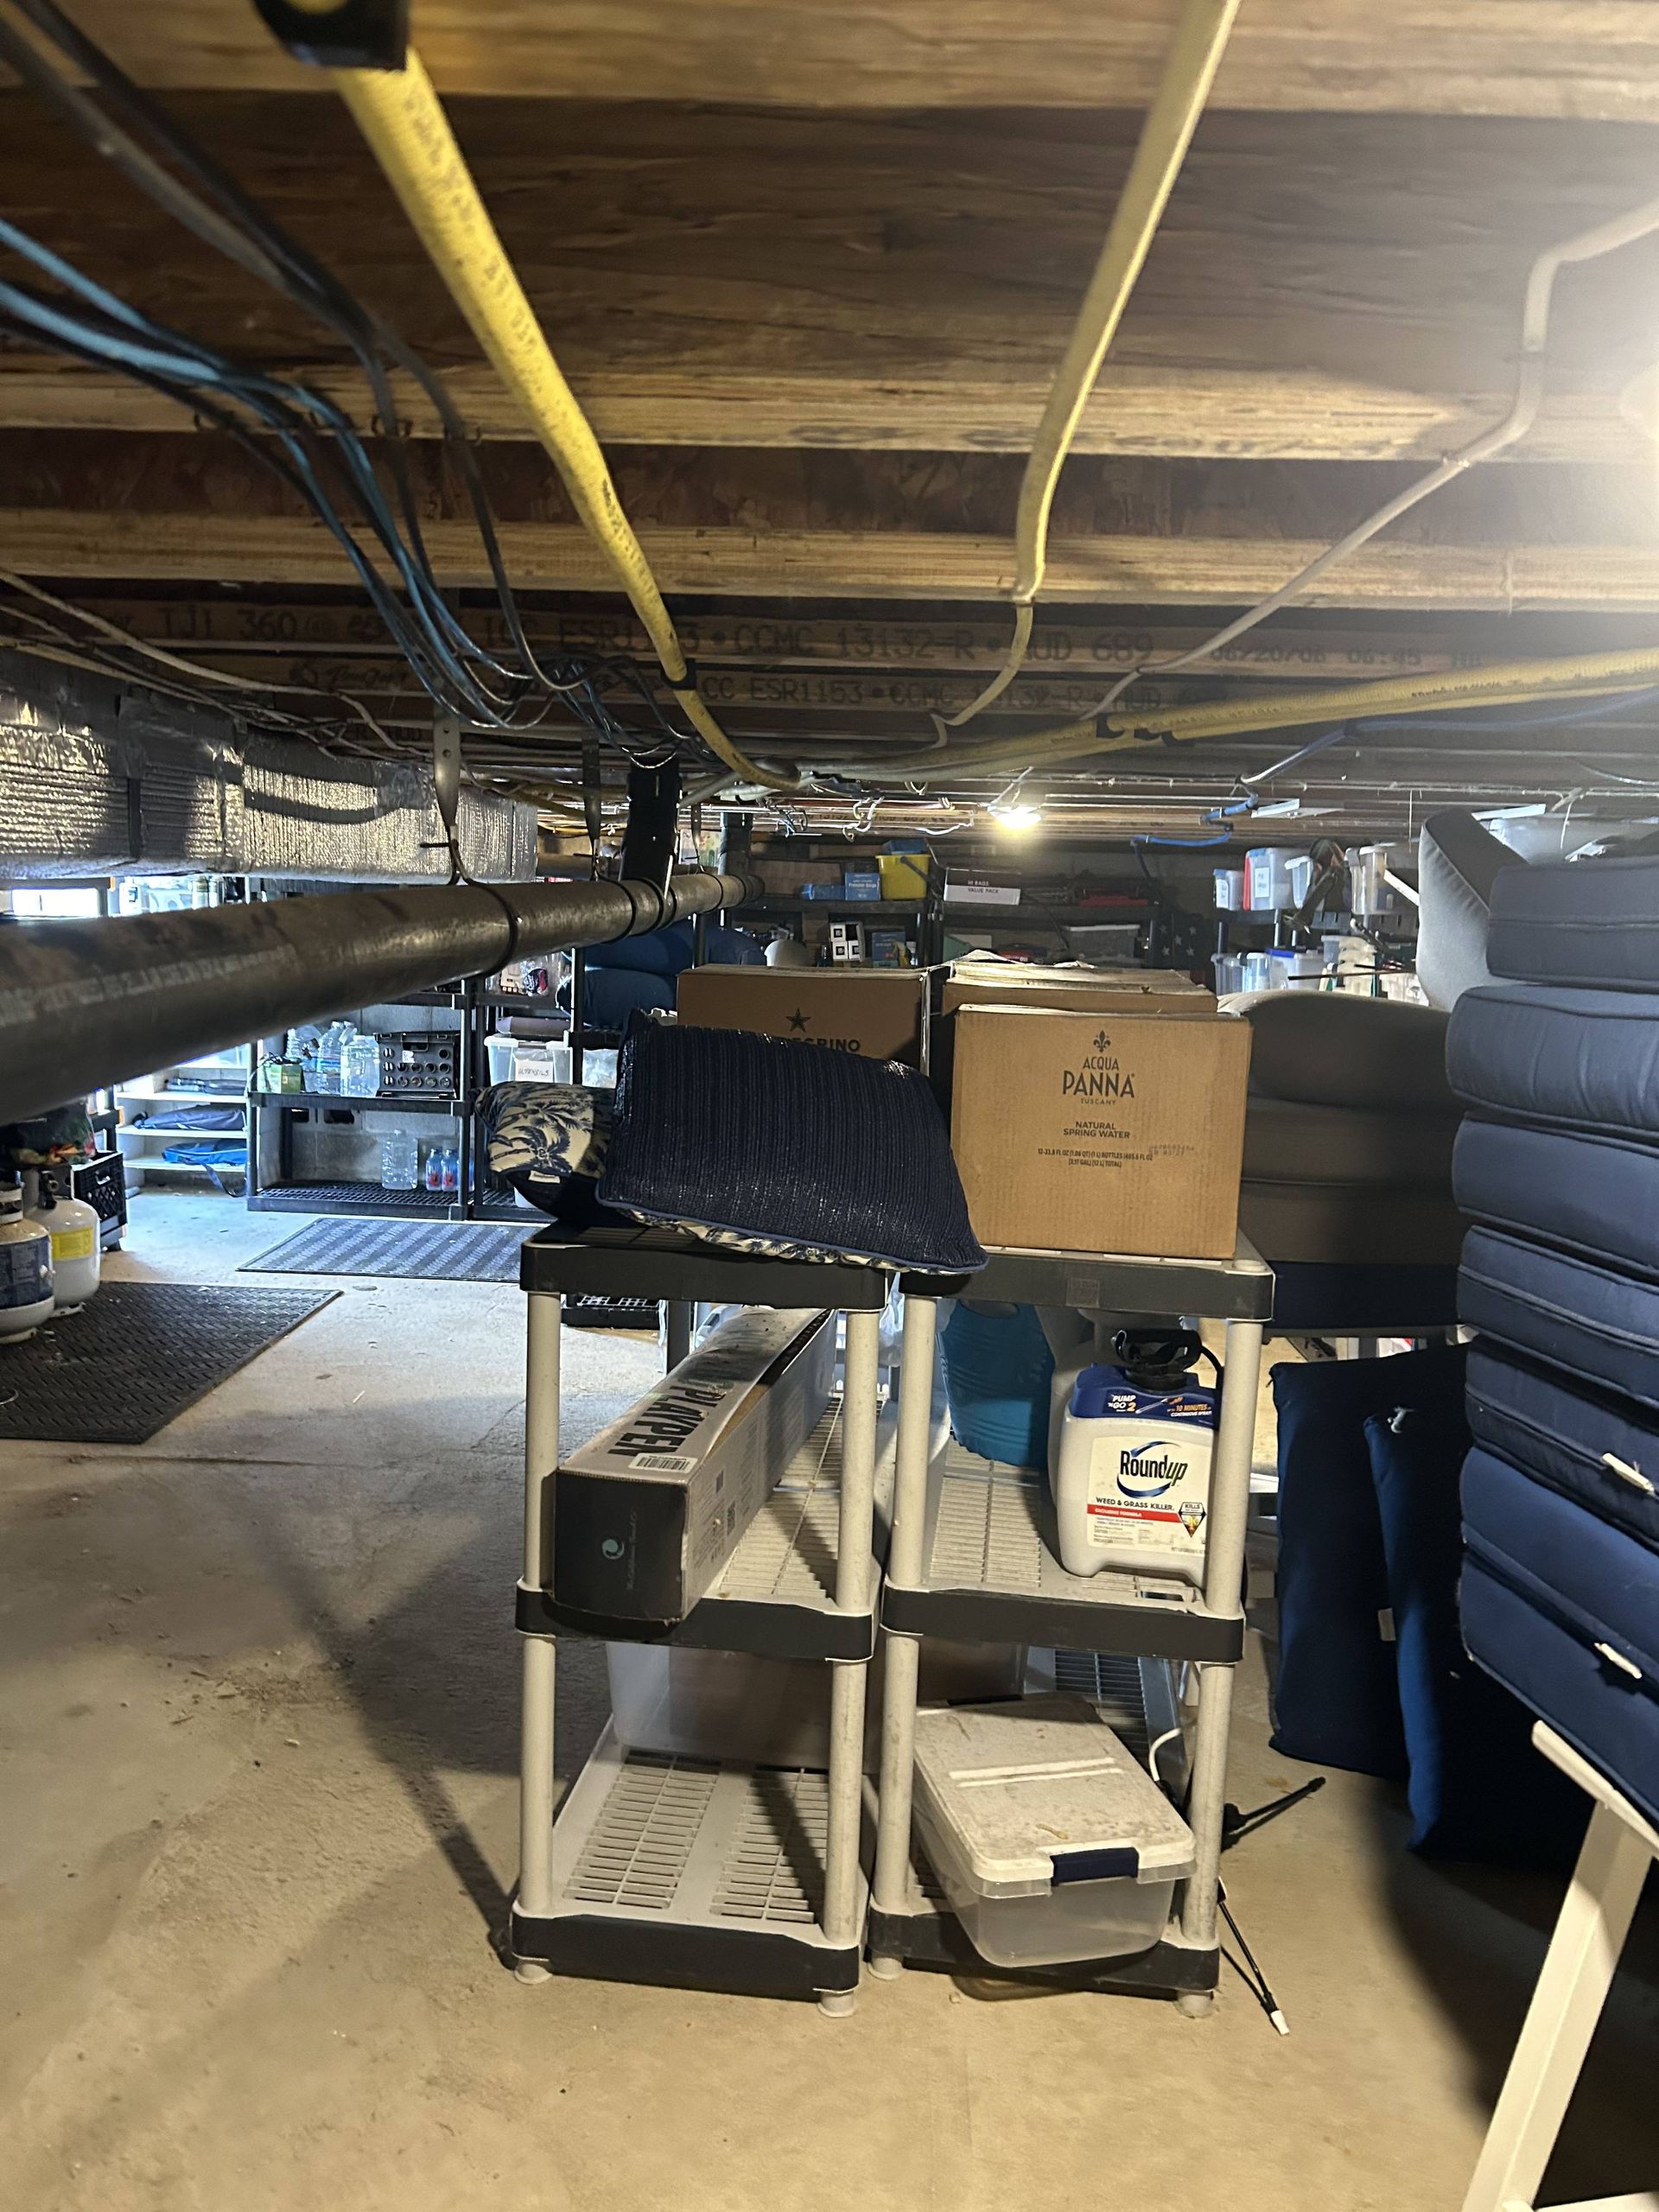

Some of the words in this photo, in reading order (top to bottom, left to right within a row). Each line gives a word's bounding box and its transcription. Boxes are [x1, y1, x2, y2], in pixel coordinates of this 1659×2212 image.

[237, 607, 297, 639] 360
[560, 617, 699, 652] ESR113
[734, 624, 811, 654] CCMC
[837, 628, 976, 661] 13132-R
[1090, 633, 1154, 662] 689
[750, 677, 862, 704] ESR1153
[1083, 1056, 1119, 1071] ACQUA
[1062, 1070, 1135, 1098] PANNA
[1063, 1128, 1096, 1138] SPRING
[1098, 1130, 1130, 1139] WATER
[1075, 1121, 1116, 1130] NATURAL
[1127, 1402, 1136, 1412] 2
[1120, 1450, 1188, 1487] Roundup
[1096, 1497, 1116, 1505] WEED
[1123, 1500, 1148, 1509] GRASS
